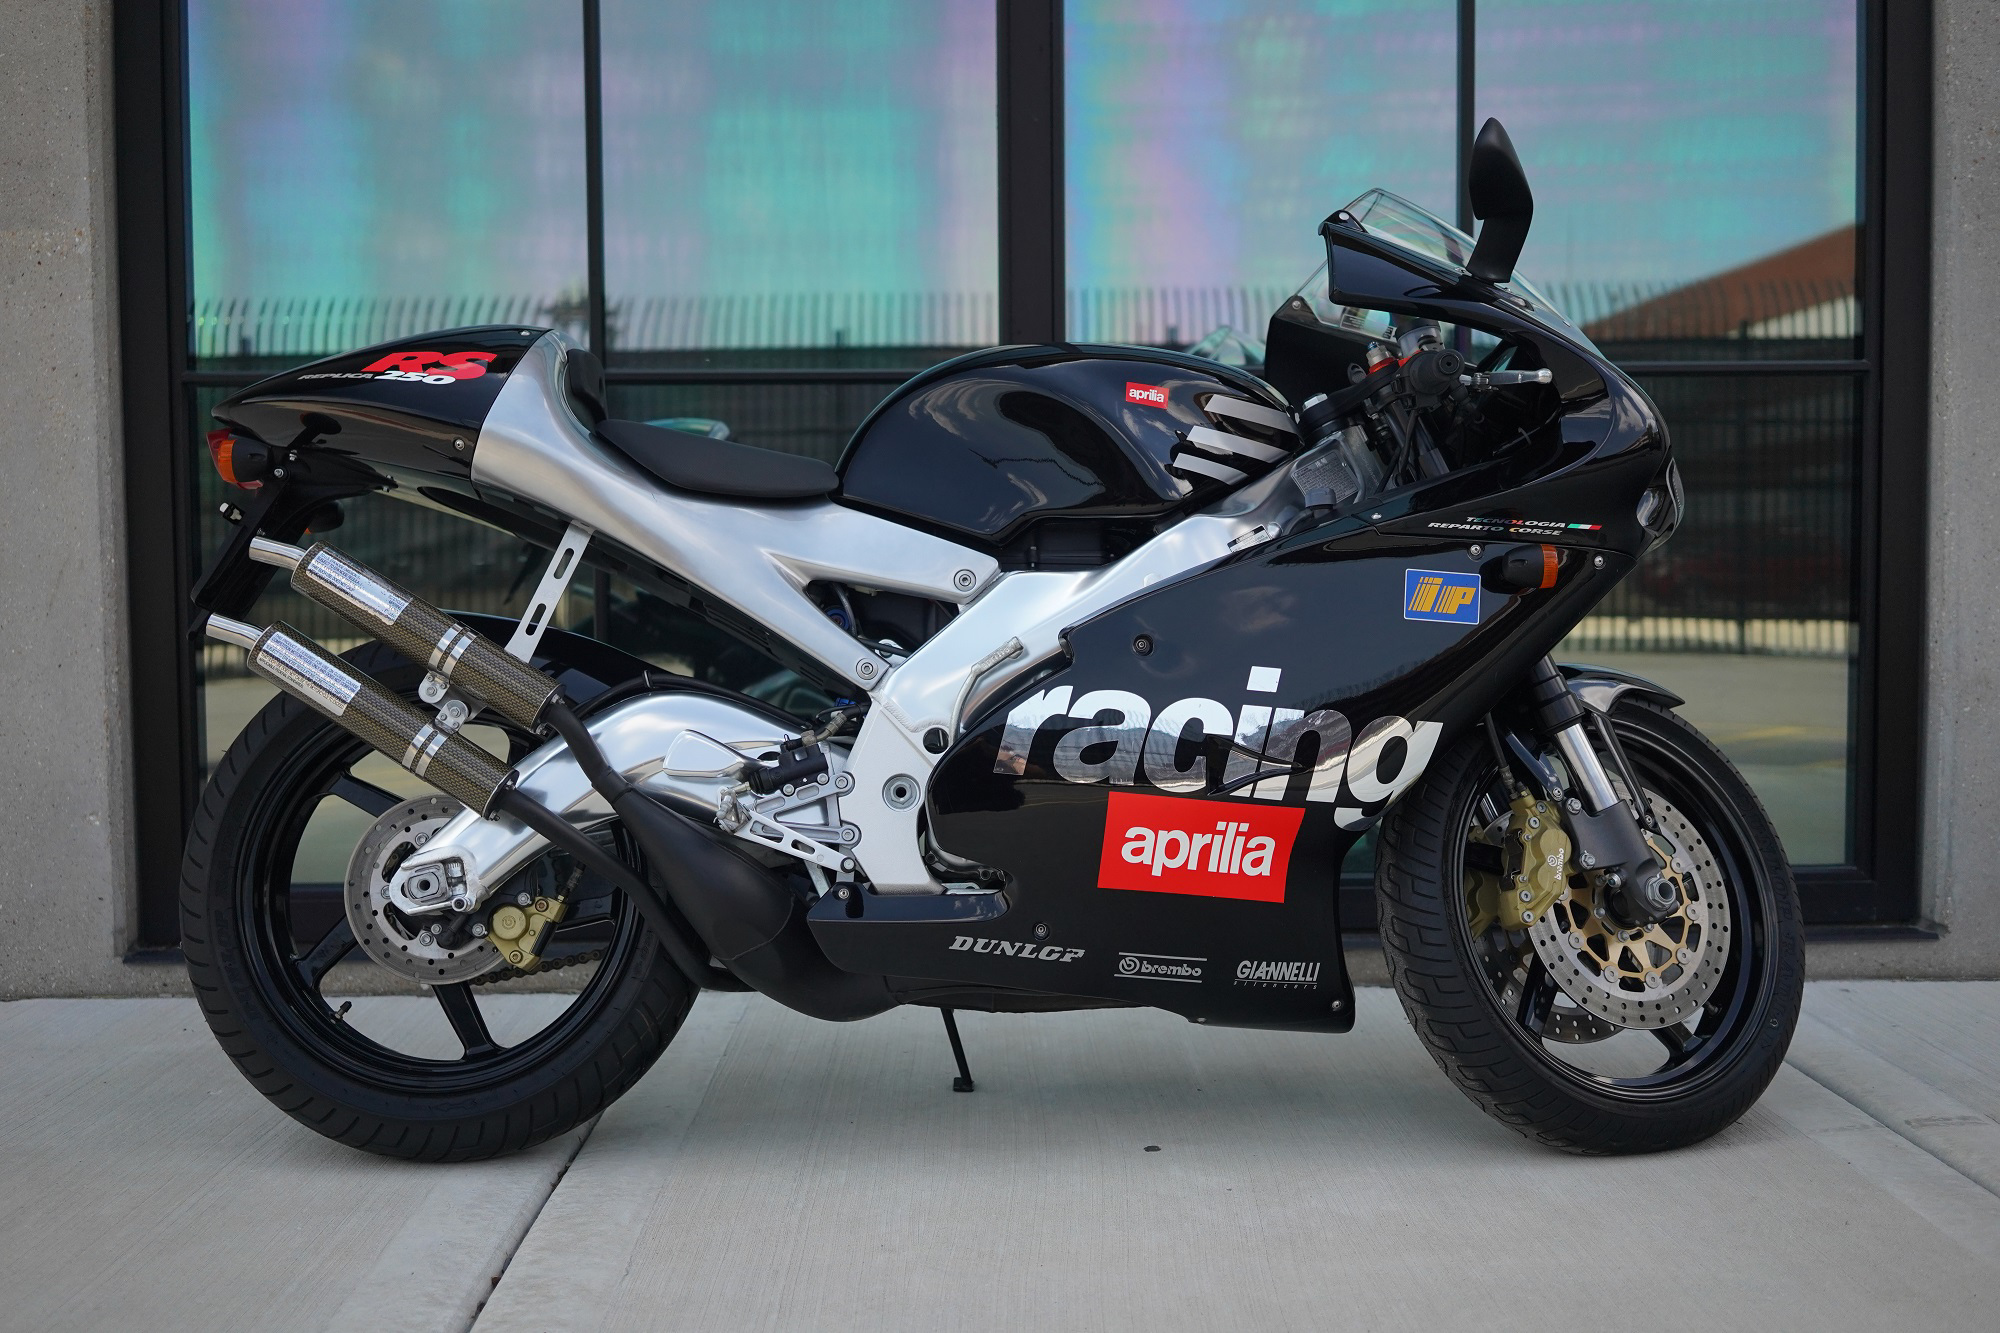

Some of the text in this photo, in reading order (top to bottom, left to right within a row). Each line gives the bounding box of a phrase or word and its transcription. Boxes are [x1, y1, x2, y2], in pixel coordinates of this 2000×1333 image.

[361, 351, 498, 379] RS
[374, 370, 456, 384] 250
[1128, 388, 1164, 403] aprilia
[1427, 522, 1563, 536] REPARTO CORSE
[1466, 516, 1566, 529] TECNOLOGIA
[993, 666, 1443, 831] racing
[1121, 821, 1276, 876] aprilia
[1554, 848, 1564, 880] brembo
[1141, 961, 1202, 977] brembo
[1236, 960, 1320, 982] GIANNELLI
